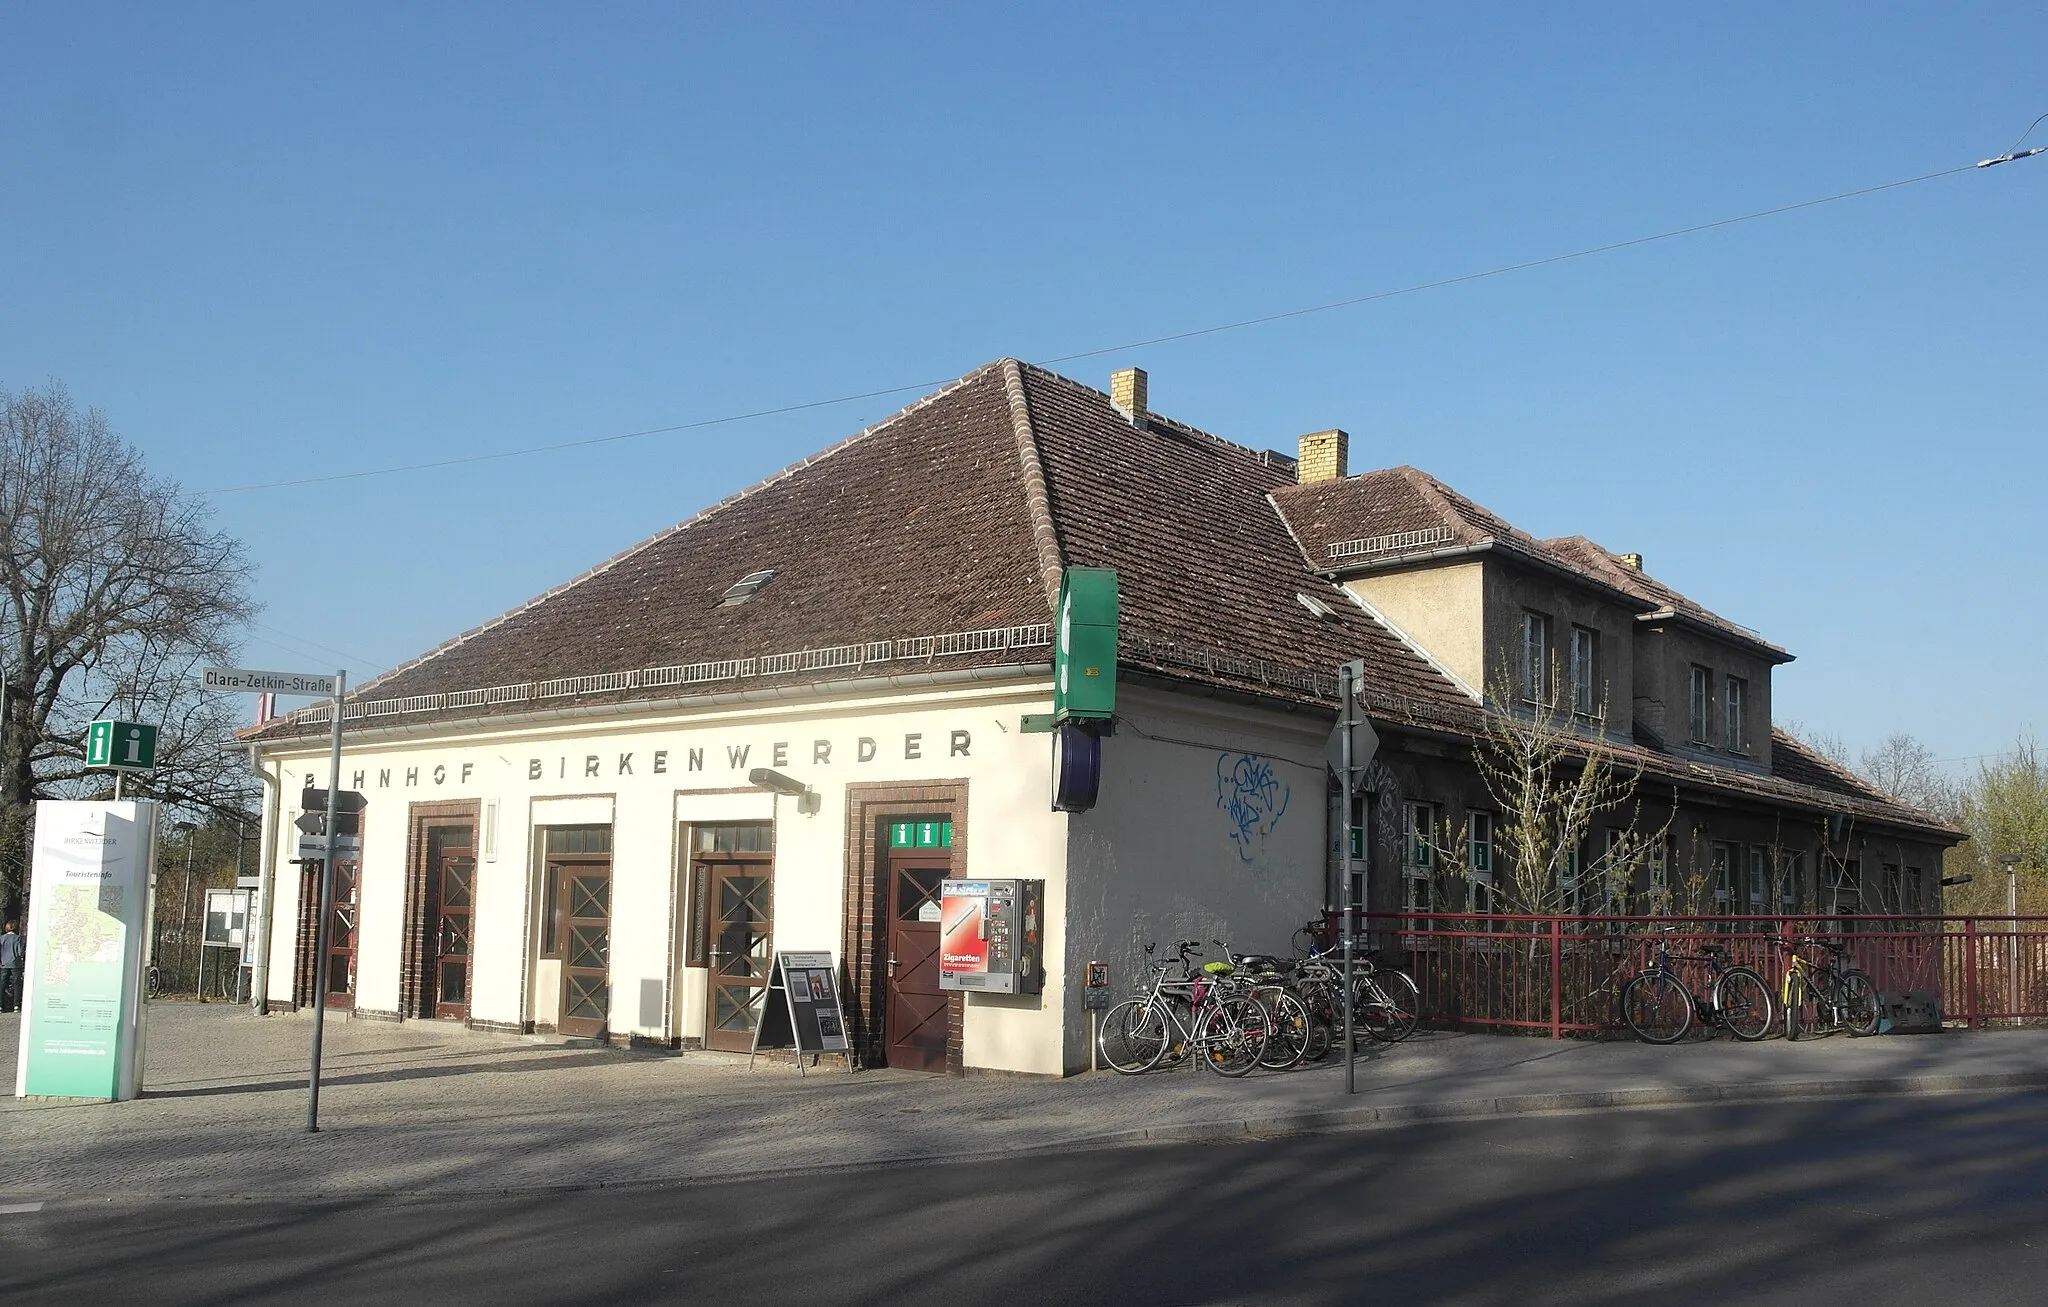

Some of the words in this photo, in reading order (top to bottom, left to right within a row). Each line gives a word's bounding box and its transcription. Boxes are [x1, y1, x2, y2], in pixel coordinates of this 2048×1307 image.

[206, 671, 332, 692] Clara-Zetkin-Straße
[305, 763, 474, 790] BHNHOF
[528, 729, 971, 780] BIRKENWERDER
[65, 870, 113, 880] Touristeninfo
[943, 953, 980, 963] Zigaretten
